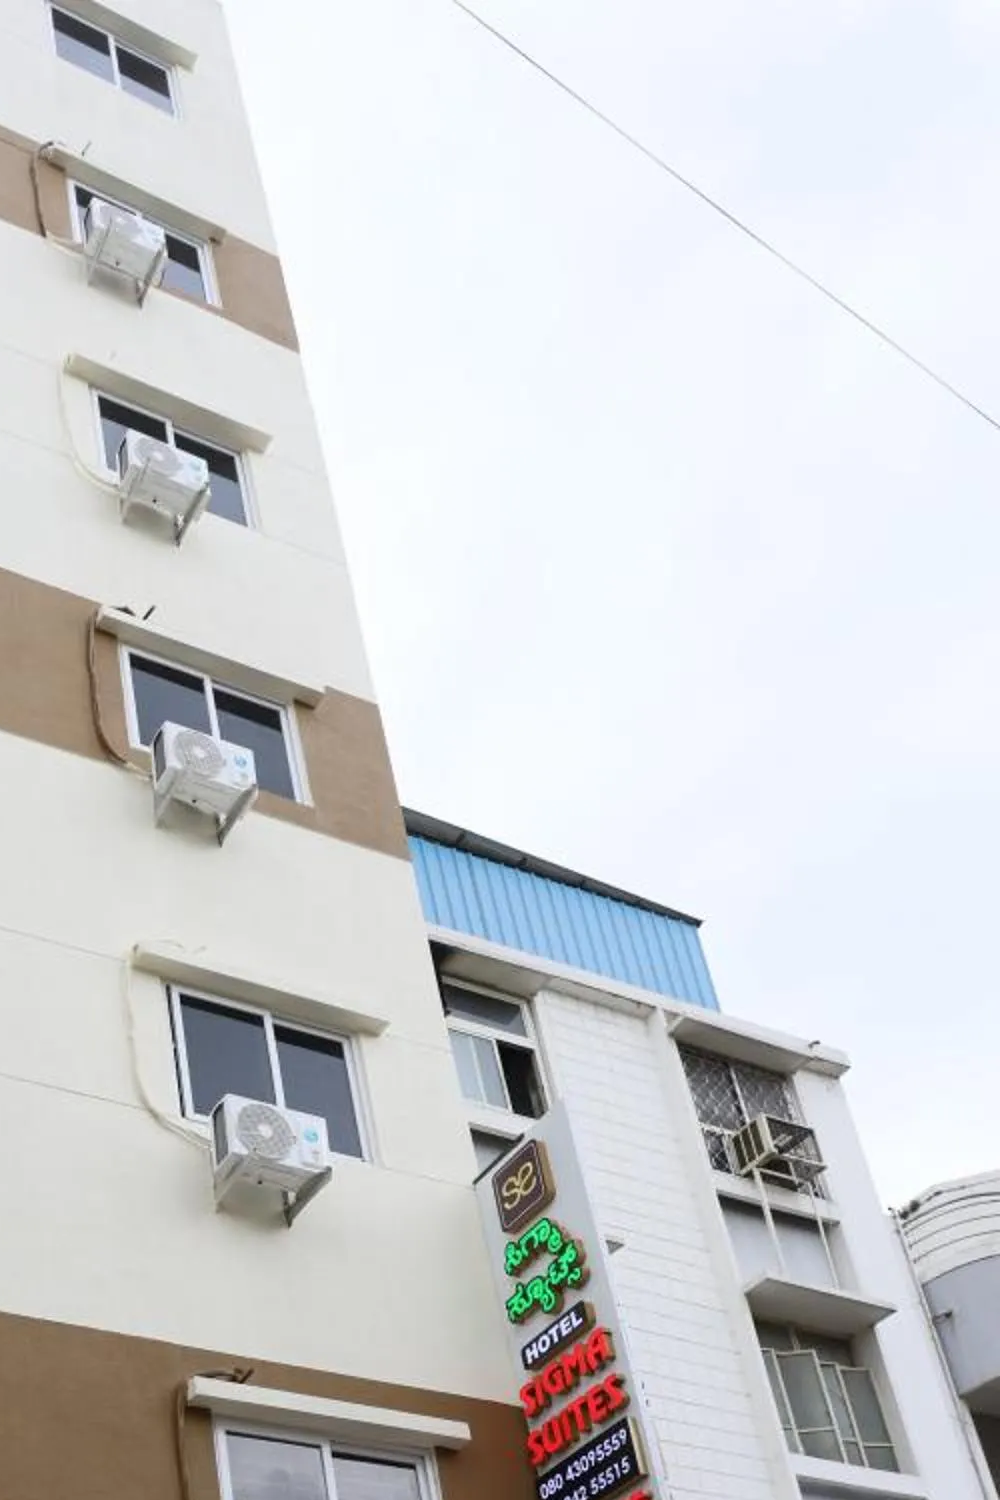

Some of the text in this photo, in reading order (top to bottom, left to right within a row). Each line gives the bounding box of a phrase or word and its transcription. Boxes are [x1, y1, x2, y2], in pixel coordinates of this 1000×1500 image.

[518, 1326, 611, 1418] SIGMA
[524, 1311, 583, 1365] HOTEL
[527, 1374, 626, 1466] SUITES
[540, 1428, 627, 1500] 080 43095559
[590, 1455, 631, 1495] 55515
